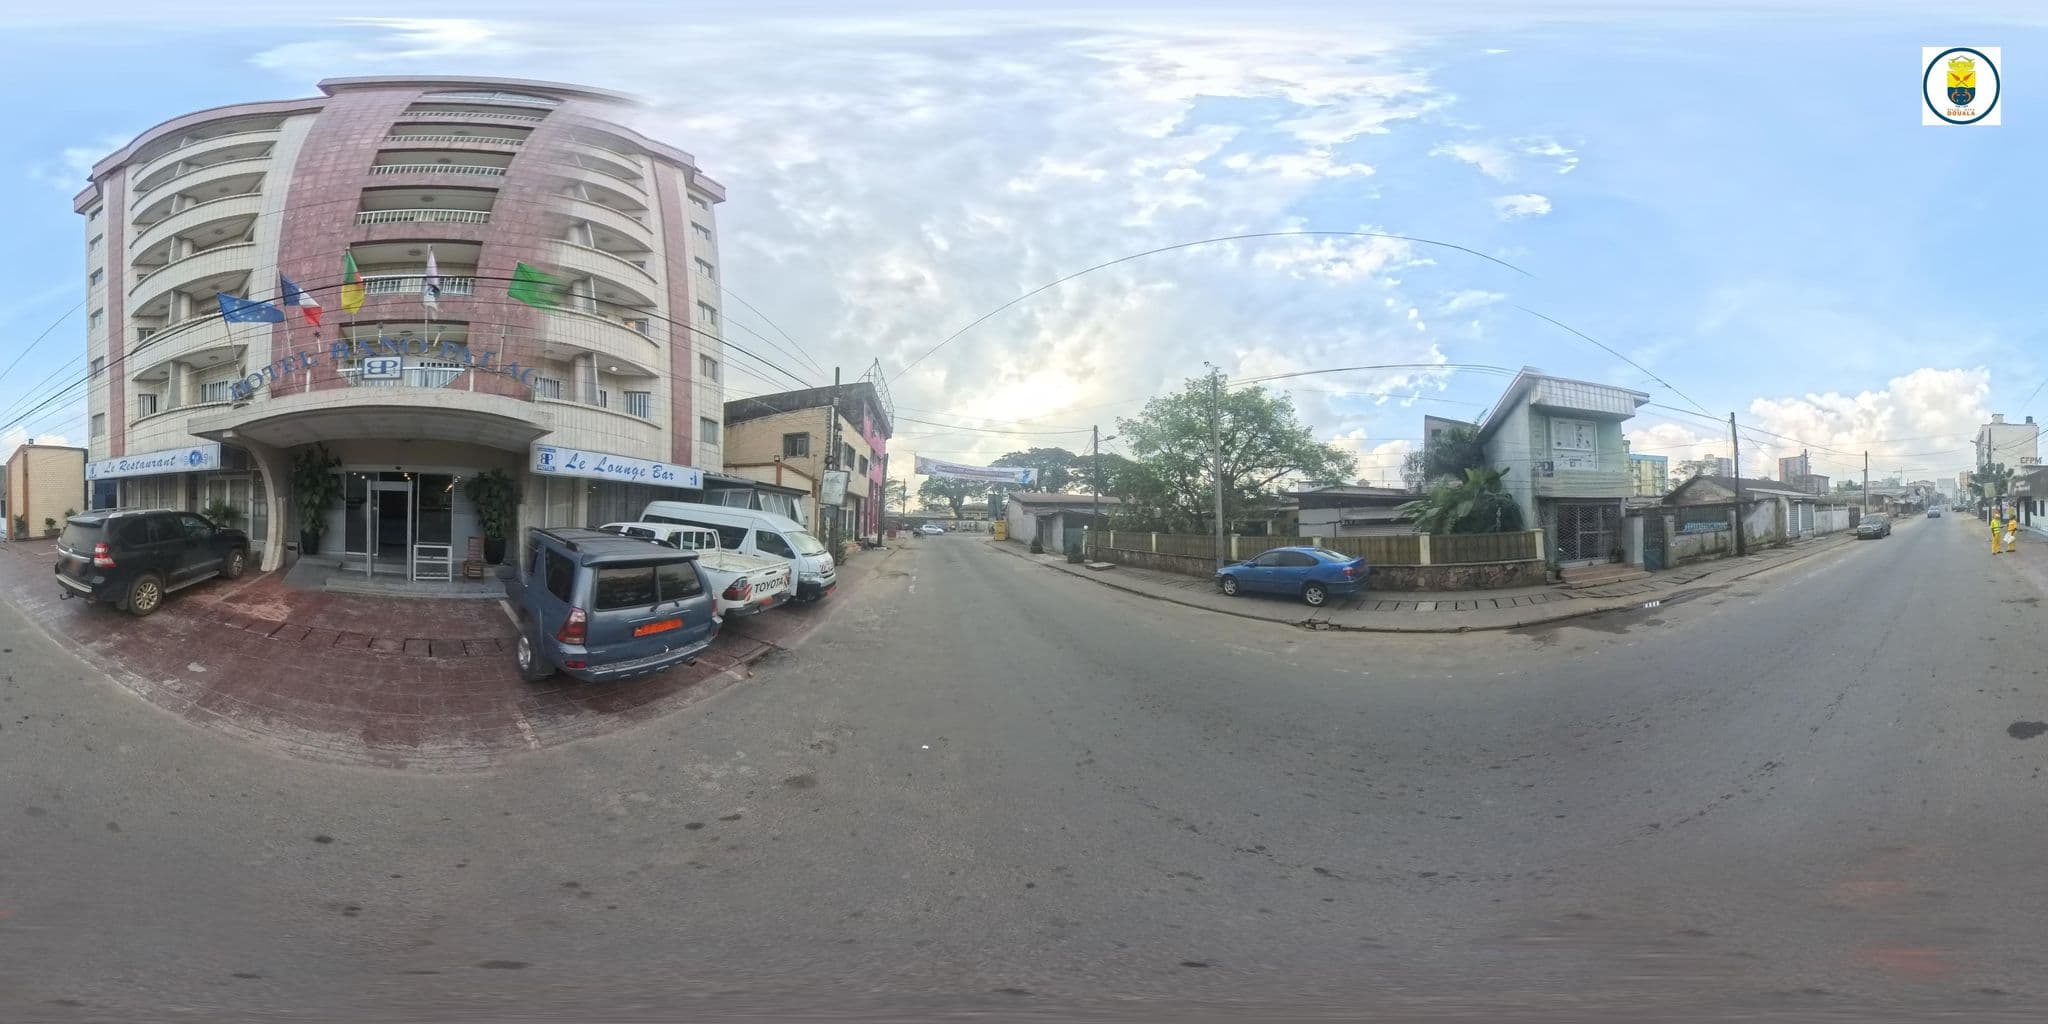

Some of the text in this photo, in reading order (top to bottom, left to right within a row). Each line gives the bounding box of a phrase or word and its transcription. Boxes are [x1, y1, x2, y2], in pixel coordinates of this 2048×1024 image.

[230, 351, 319, 400] HOTEL
[104, 462, 115, 474] Le
[119, 455, 177, 472] Restaurant
[565, 453, 674, 481] Le Lounge Bar
